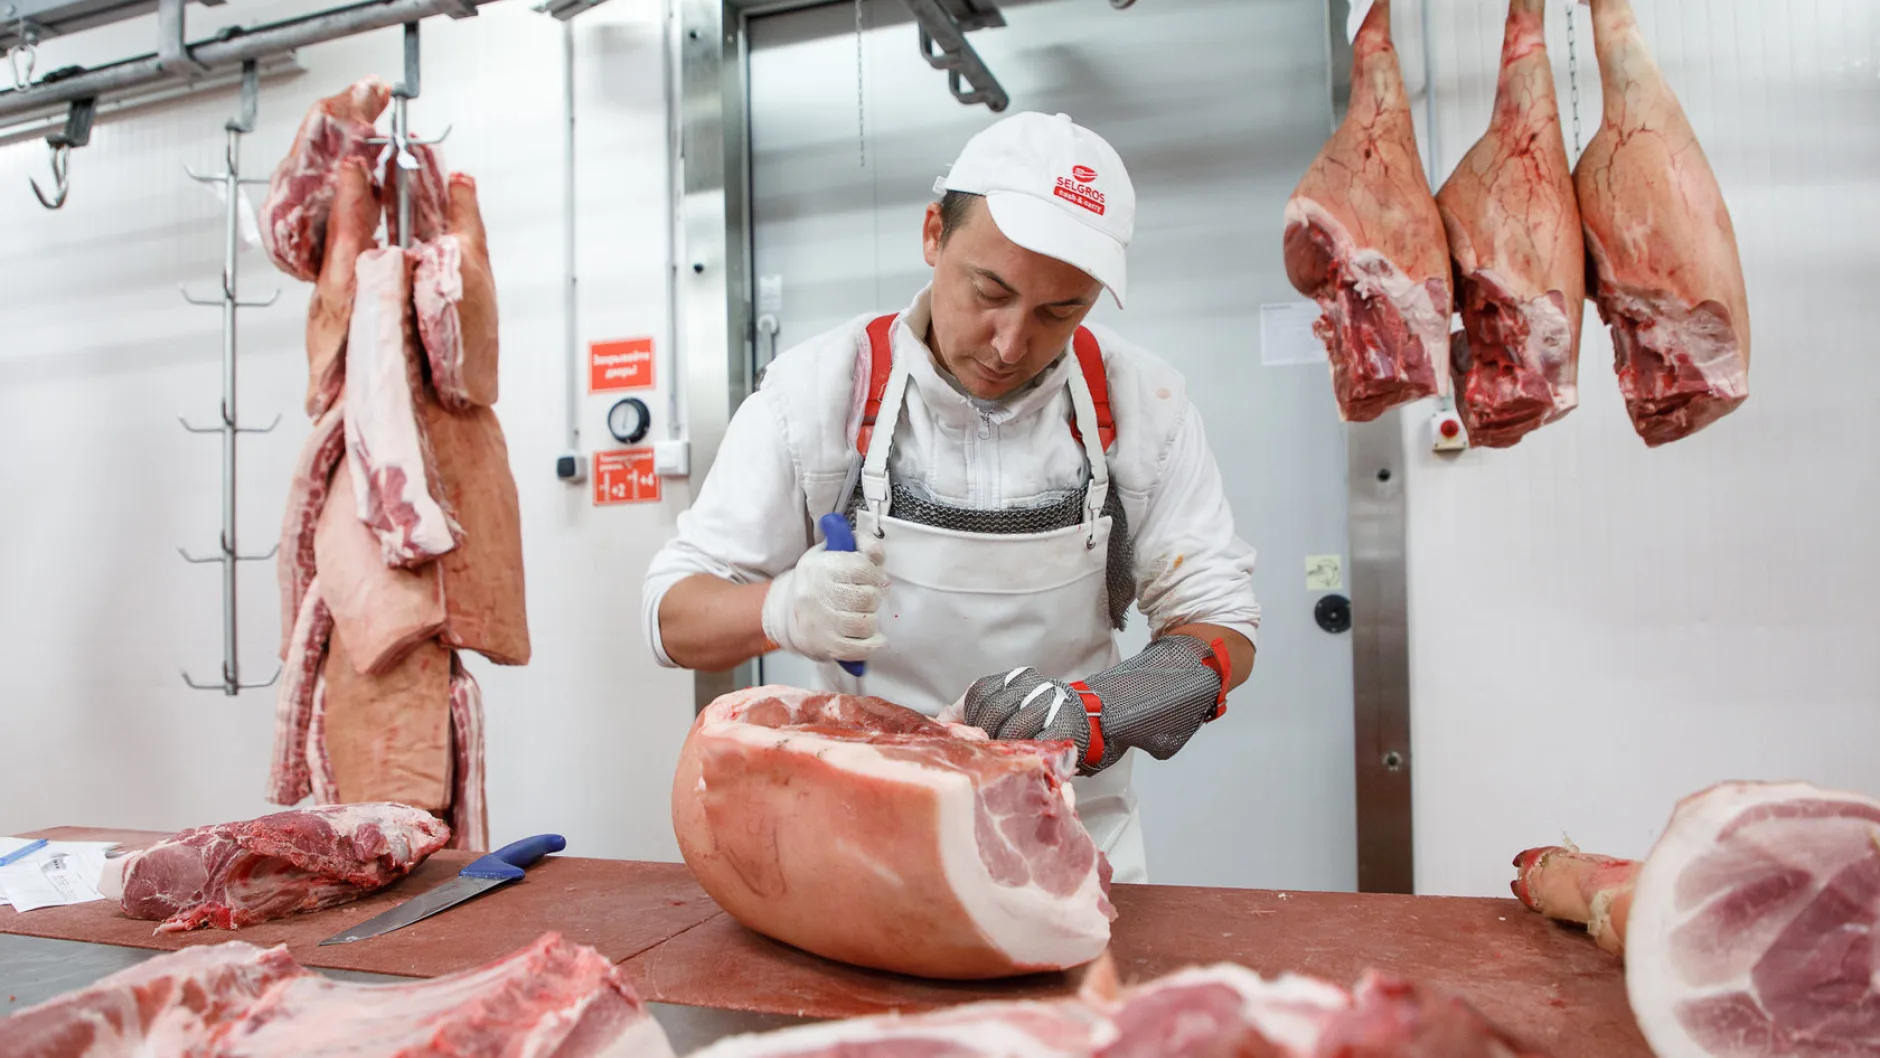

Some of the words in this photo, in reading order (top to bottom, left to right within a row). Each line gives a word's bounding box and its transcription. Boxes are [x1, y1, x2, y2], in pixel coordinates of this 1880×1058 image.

[1056, 176, 1105, 203] SELGROS
[1058, 189, 1076, 202] cash
[1083, 200, 1101, 213] carry
